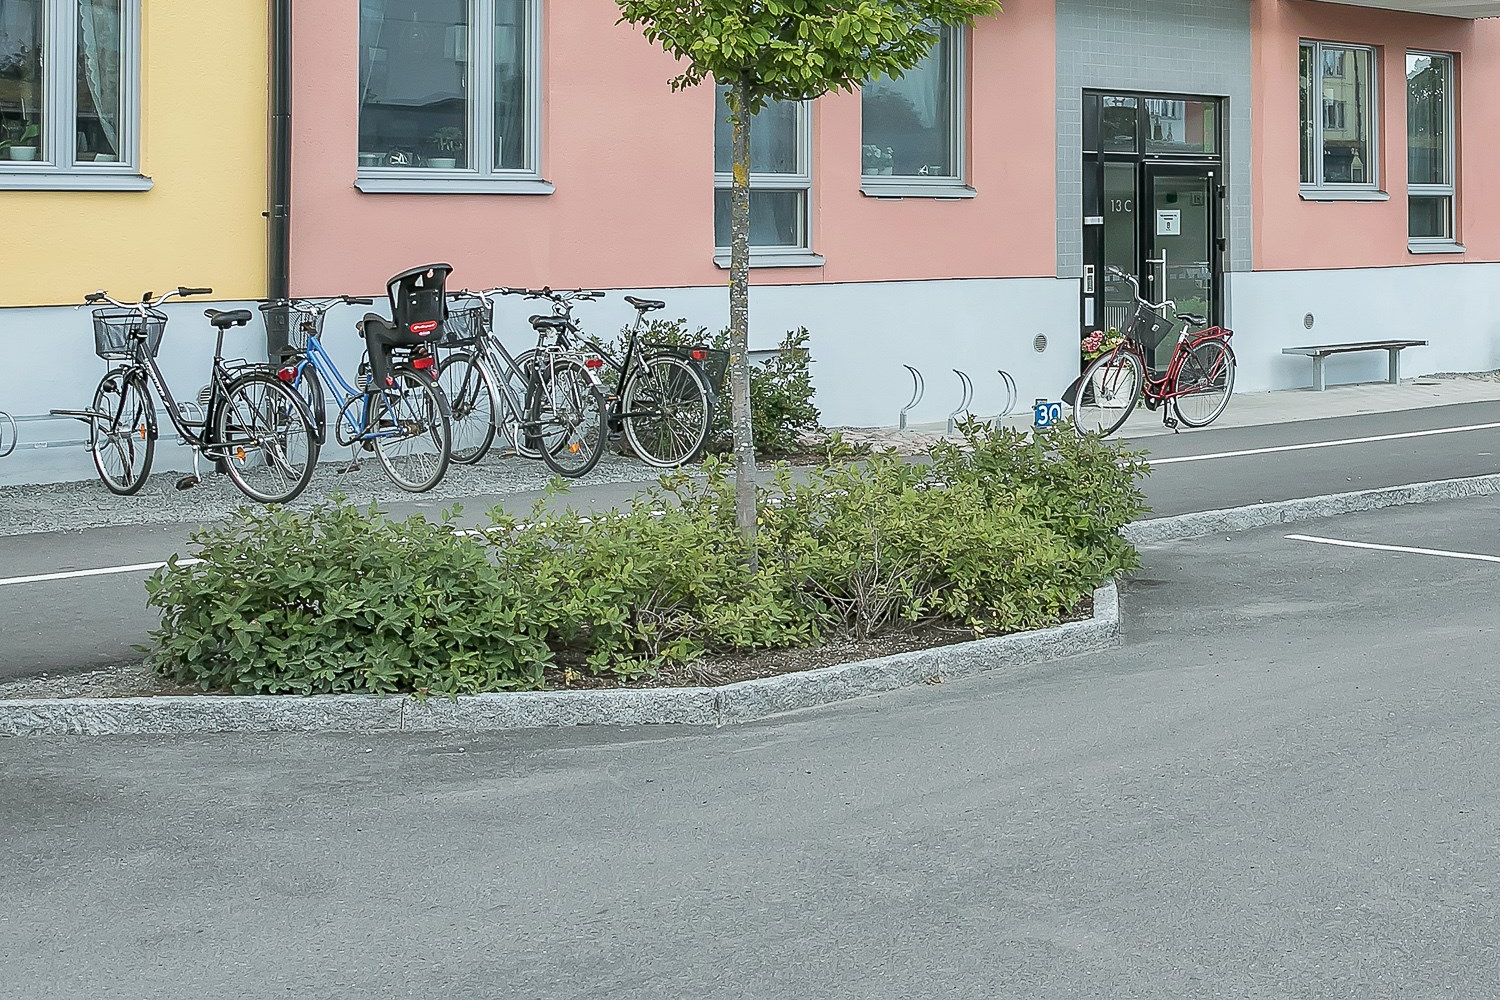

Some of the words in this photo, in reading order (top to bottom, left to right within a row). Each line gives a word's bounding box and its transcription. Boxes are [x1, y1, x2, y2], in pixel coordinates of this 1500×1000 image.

[1110, 199, 1122, 212] 13
[1124, 199, 1132, 212] C
[1037, 403, 1061, 425] 30
